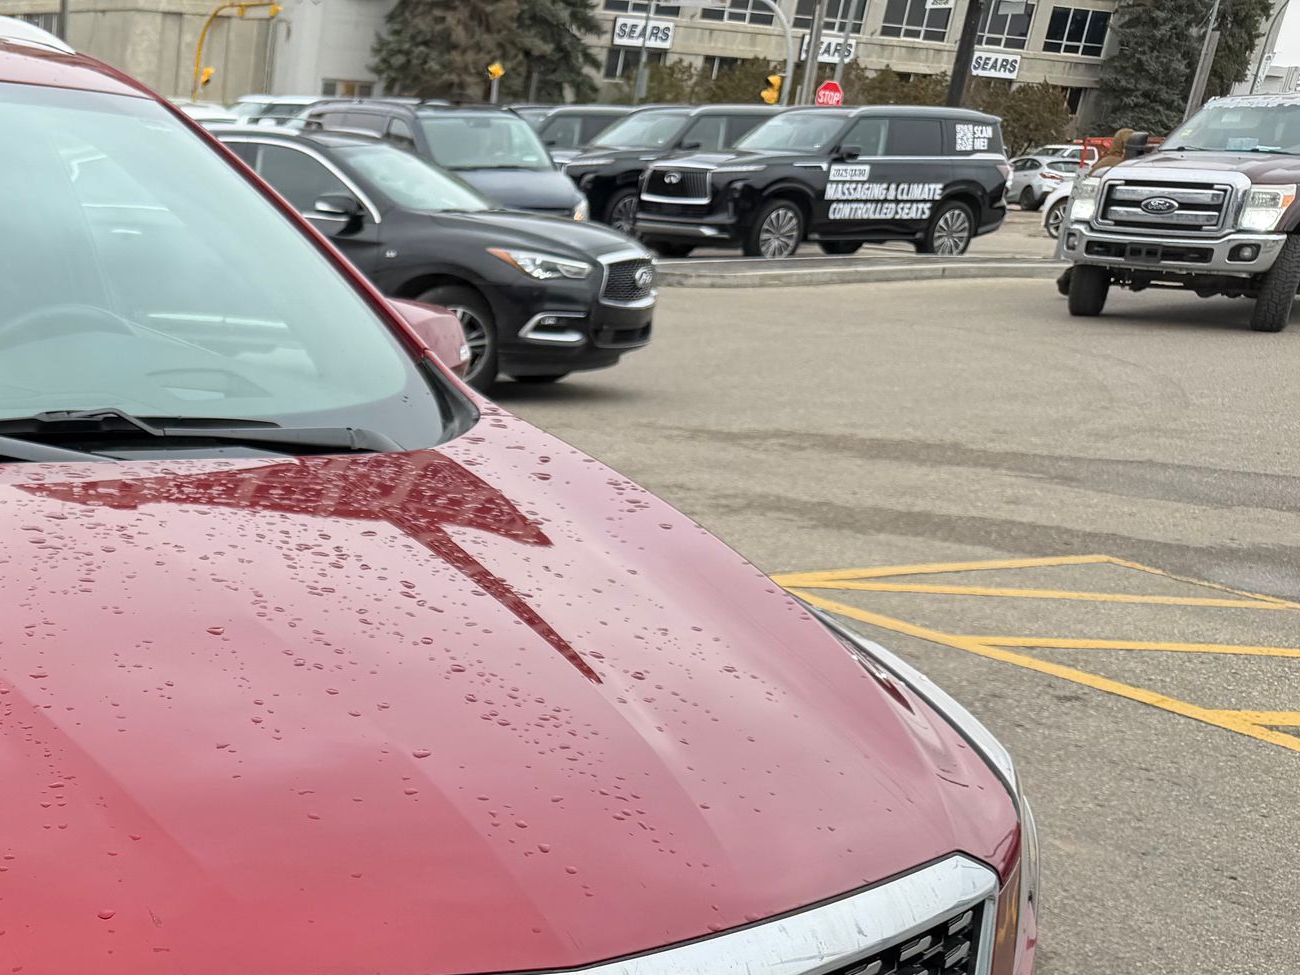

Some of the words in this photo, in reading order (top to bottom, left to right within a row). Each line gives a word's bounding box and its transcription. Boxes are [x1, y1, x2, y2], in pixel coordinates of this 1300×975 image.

[617, 22, 671, 43] SEARS
[806, 40, 853, 57] ARS
[972, 55, 1018, 74] SEARS
[817, 89, 840, 105] STOP
[973, 125, 993, 138] SCAN
[832, 168, 848, 177] 2025
[825, 182, 888, 200] MASSAGING
[886, 184, 897, 200] &
[897, 183, 944, 200] CLIMATE
[828, 202, 896, 219] CONTROLLED
[895, 202, 932, 219] SEATS
